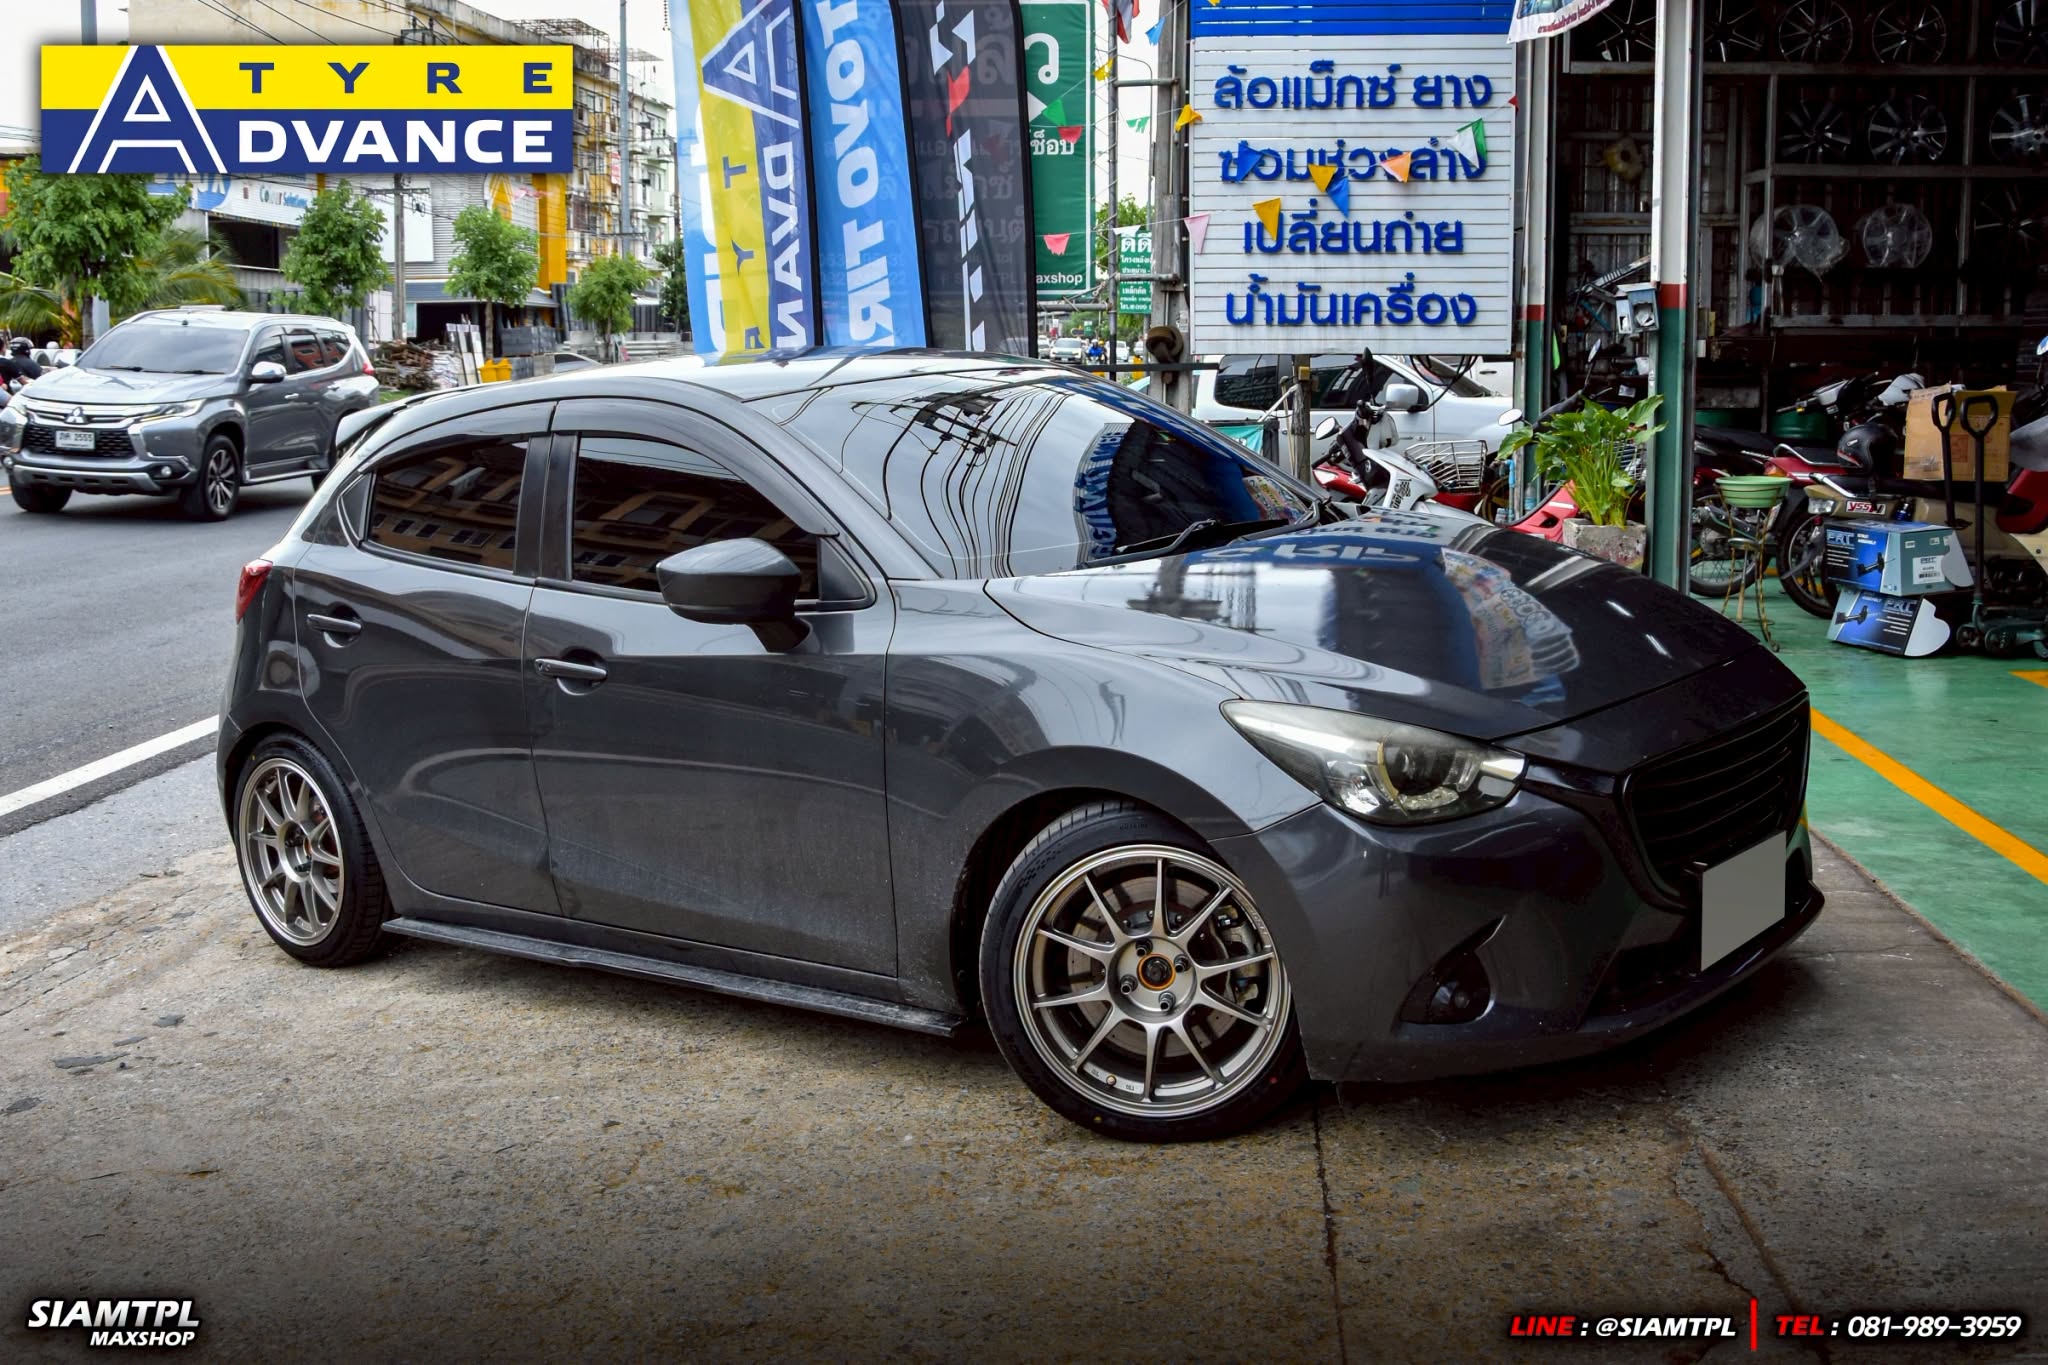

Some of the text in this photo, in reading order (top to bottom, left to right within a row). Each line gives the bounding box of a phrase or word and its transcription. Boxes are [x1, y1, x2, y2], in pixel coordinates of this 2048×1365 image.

[1413, 74, 1493, 108] ยาง
[1036, 272, 1083, 286] axshop
[1226, 272, 1477, 325] น้ำมันเครื่อง
